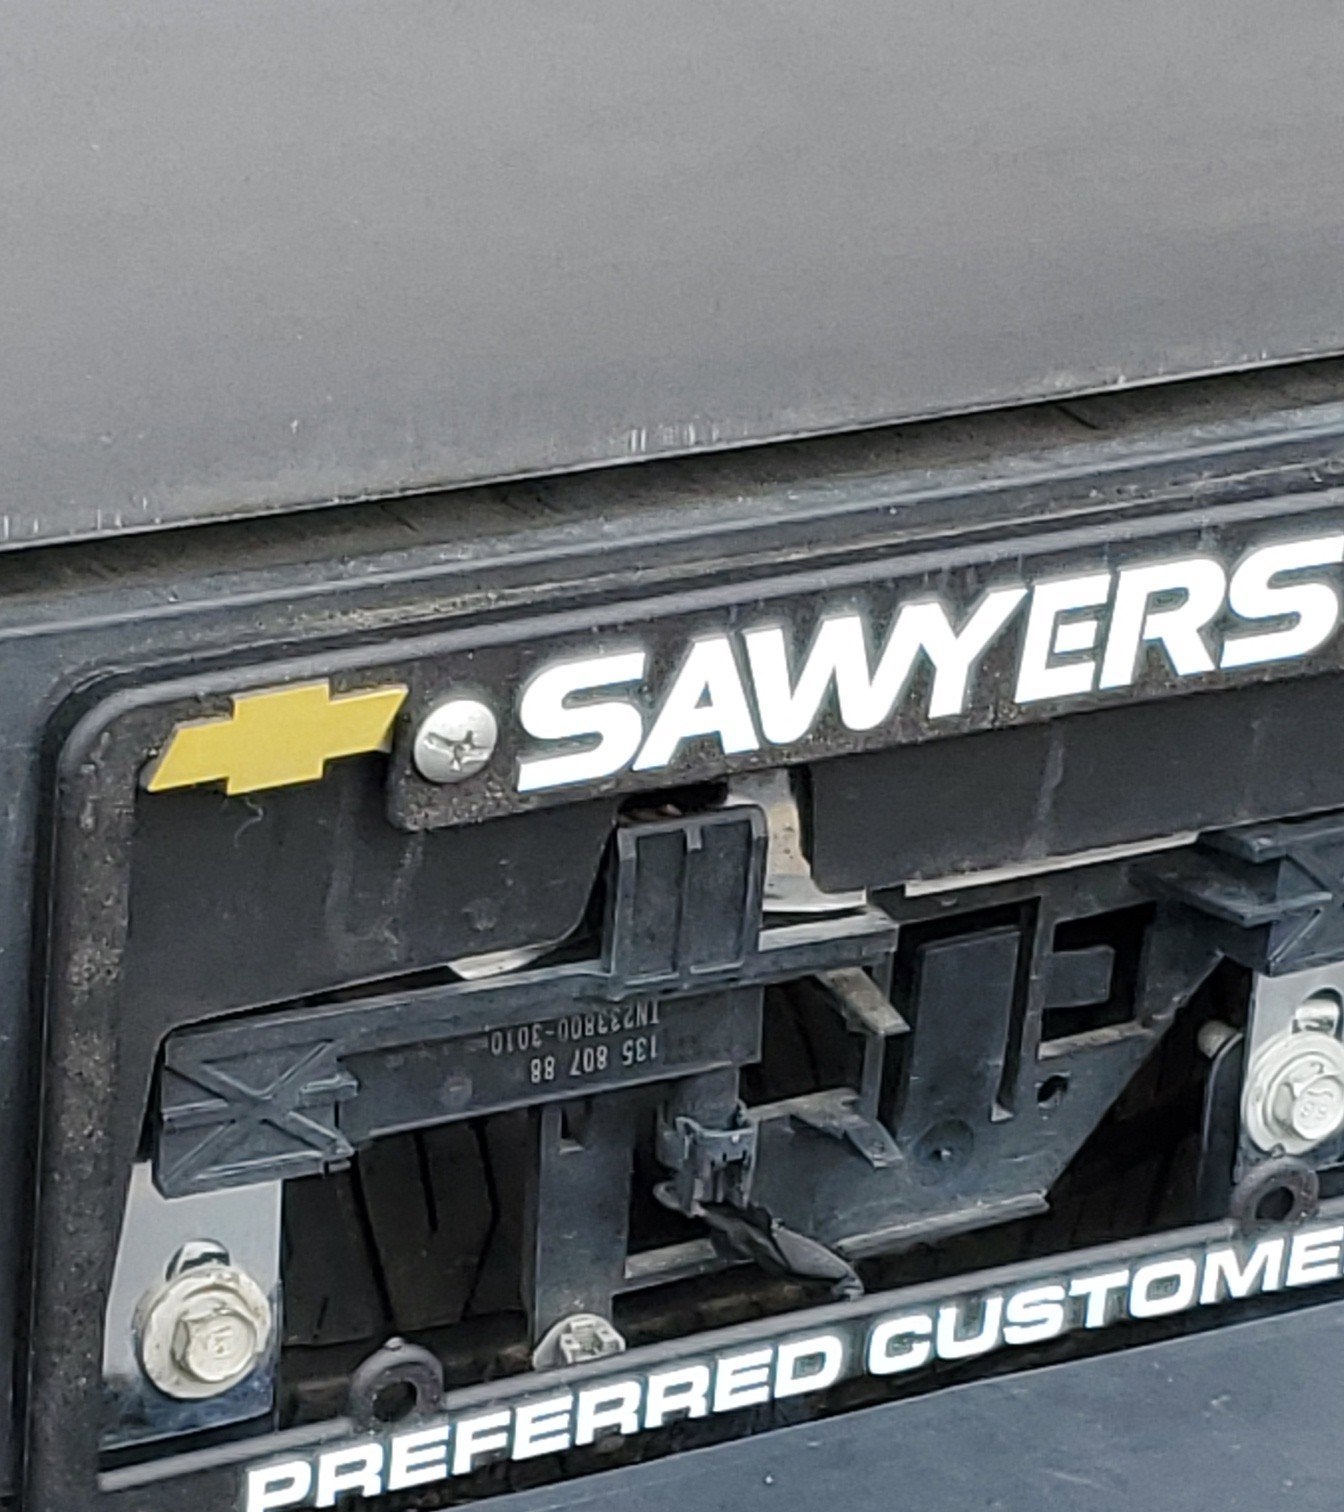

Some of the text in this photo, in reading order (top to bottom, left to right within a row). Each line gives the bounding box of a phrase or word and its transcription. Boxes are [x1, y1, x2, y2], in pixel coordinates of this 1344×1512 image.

[530, 1034, 657, 1084] 135 807 88
